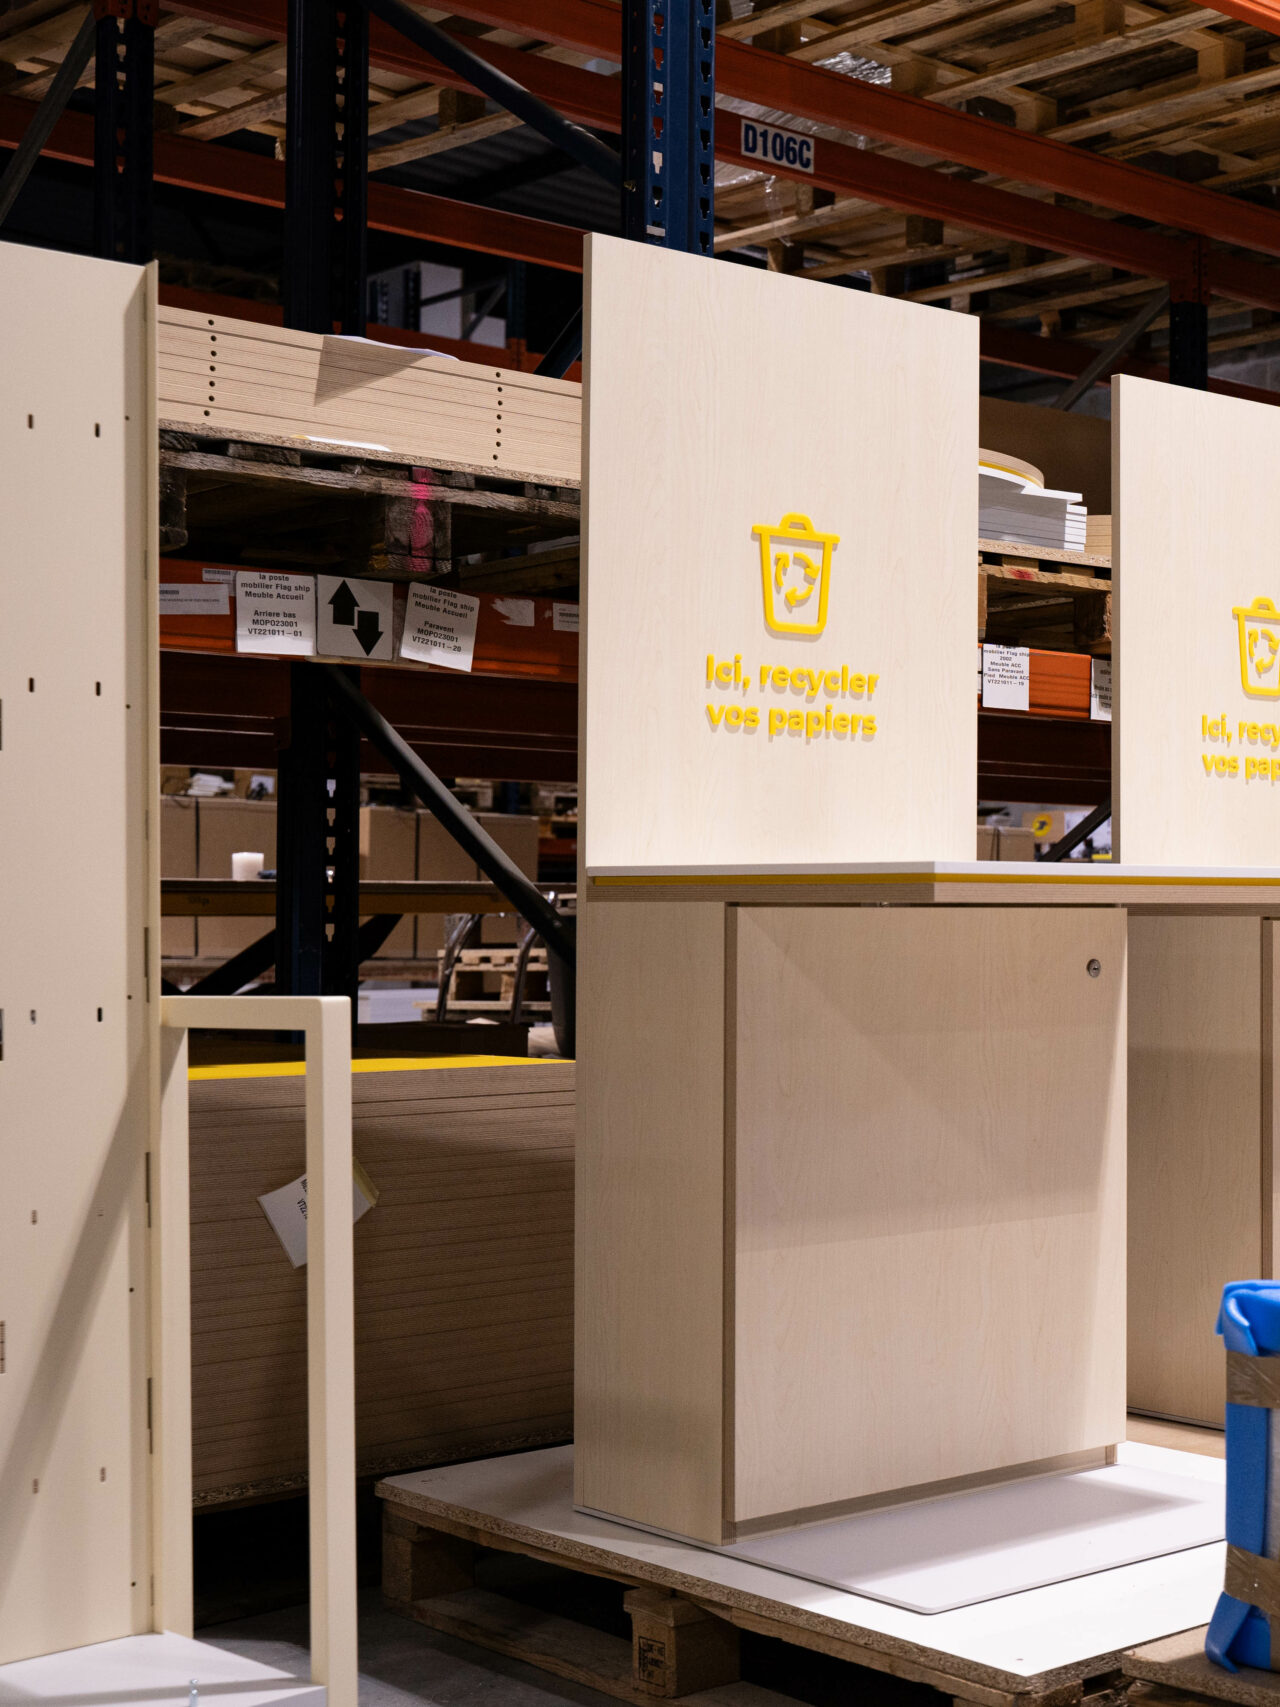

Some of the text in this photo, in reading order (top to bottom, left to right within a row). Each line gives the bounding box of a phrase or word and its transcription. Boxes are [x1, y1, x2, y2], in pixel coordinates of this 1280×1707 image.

[744, 123, 812, 169] D106C
[241, 582, 273, 590] mobilier
[275, 583, 292, 592] Flag
[269, 574, 290, 582] poste
[244, 591, 274, 599] Meuble
[412, 592, 475, 612] mobilier Flag ship
[253, 610, 297, 619] Arriere bas
[414, 601, 468, 619] Meuble Accueil
[706, 653, 880, 697] Ici, recycler
[706, 703, 878, 738] vos papiers
[1202, 712, 1232, 743] Ici,
[1201, 753, 1240, 773] vos
